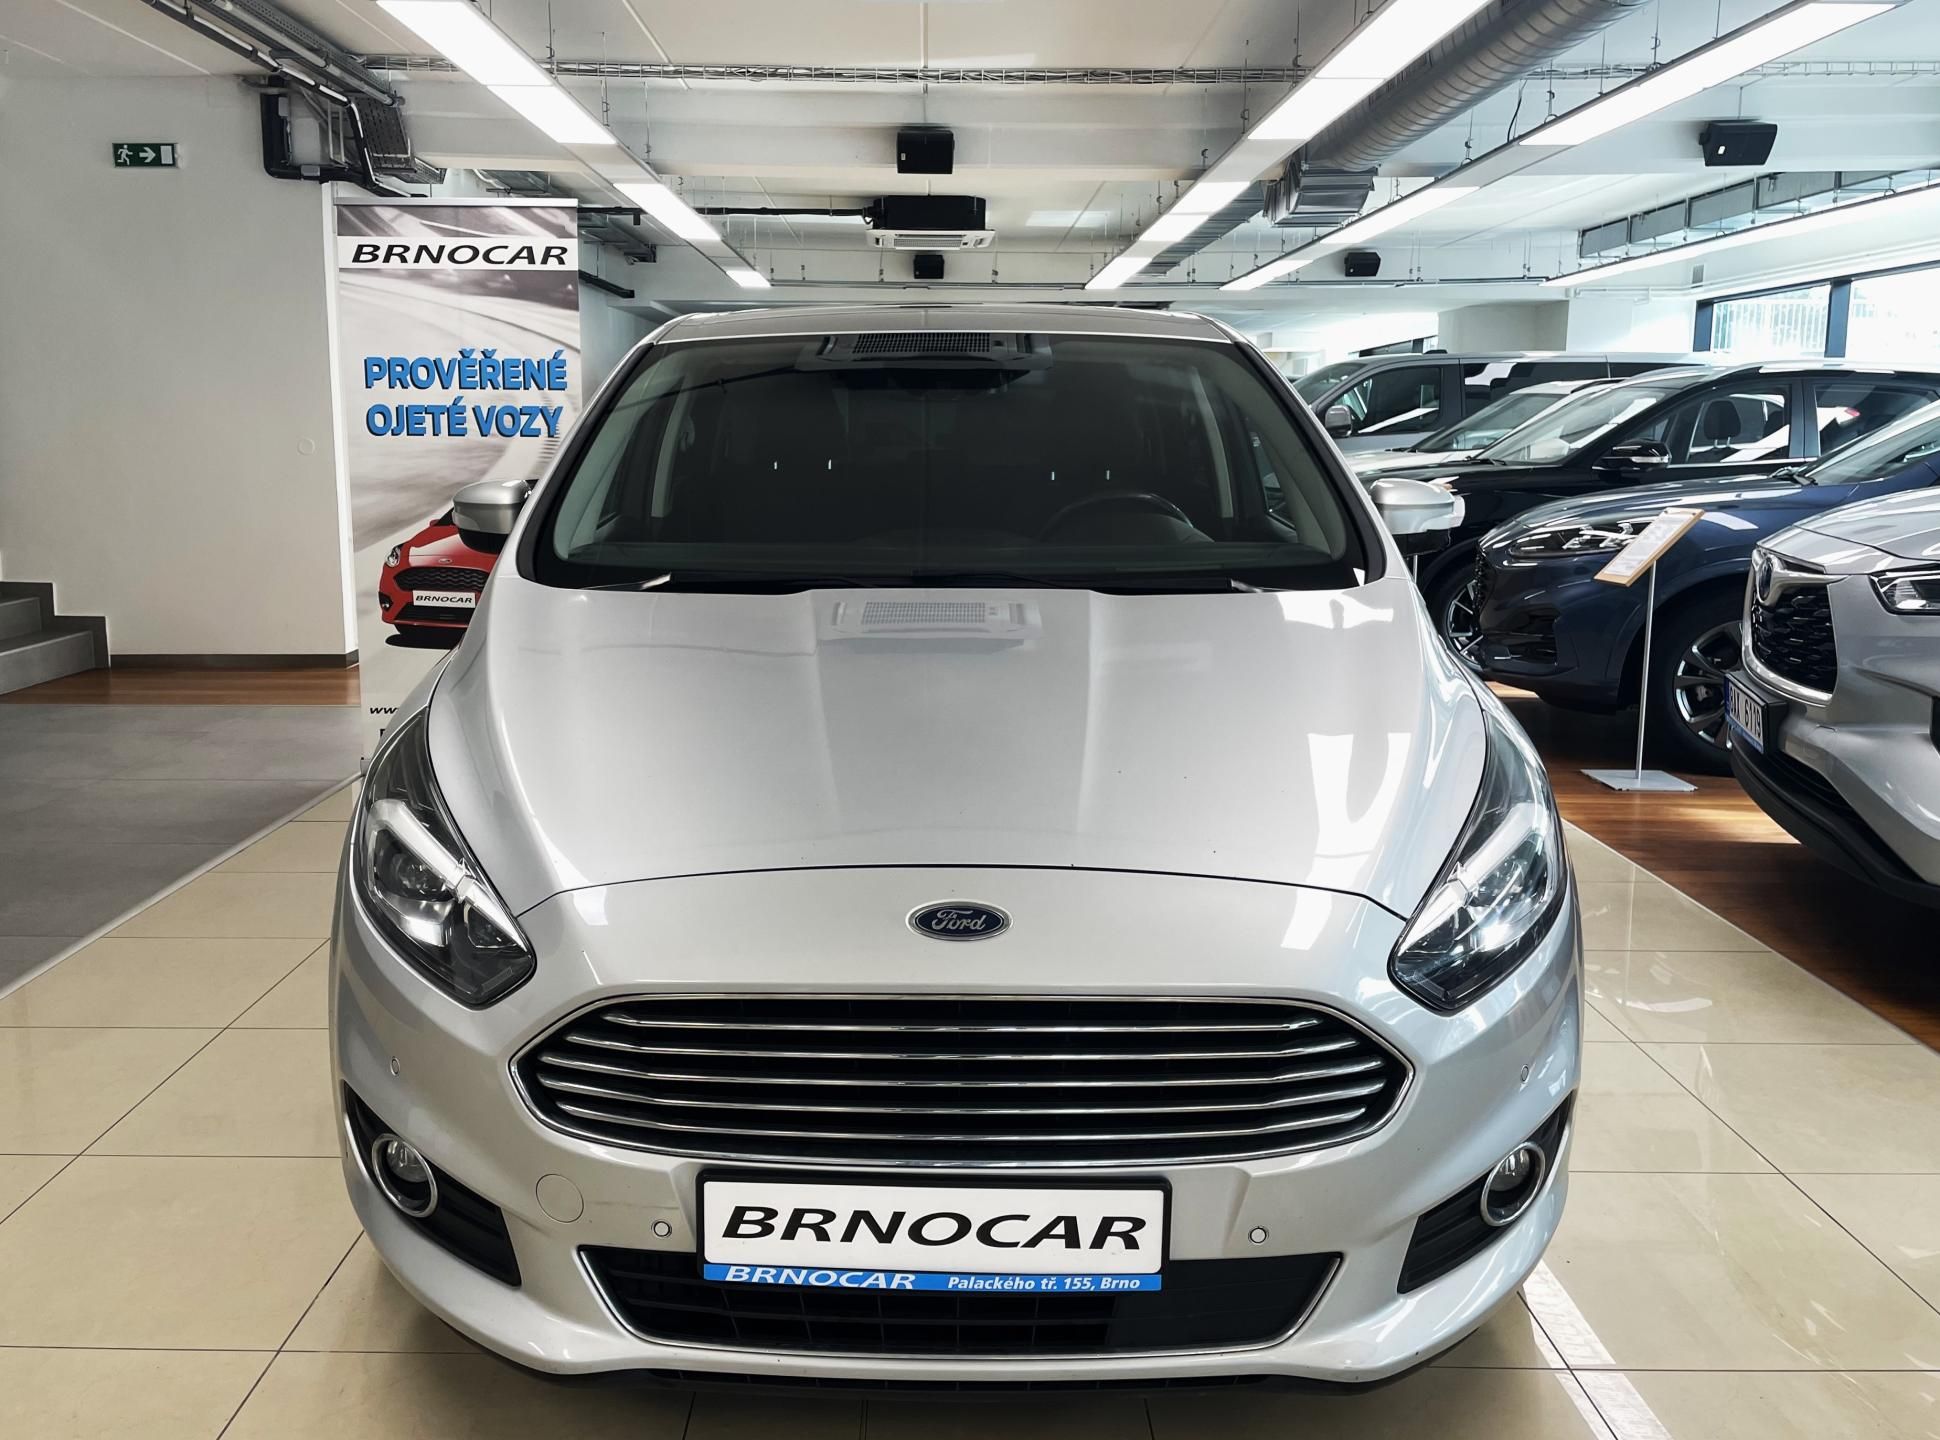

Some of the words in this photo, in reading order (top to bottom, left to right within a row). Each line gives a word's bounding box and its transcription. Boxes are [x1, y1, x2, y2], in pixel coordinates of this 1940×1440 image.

[351, 244, 568, 265] BRNOCAR
[364, 348, 568, 391] PROVĚŘENÉ
[366, 395, 467, 437] OJETÉ
[472, 404, 563, 437] VOZY
[415, 595, 473, 604] BRNOCAR
[931, 909, 987, 930] Ford
[721, 1205, 1147, 1250] BRNOCAR
[724, 1265, 916, 1290] BRNOCAR
[947, 1276, 1035, 1290] Palackého
[1040, 1276, 1057, 1290] tř.
[1064, 1277, 1096, 1292] 155,
[1100, 1277, 1141, 1290] Brno
